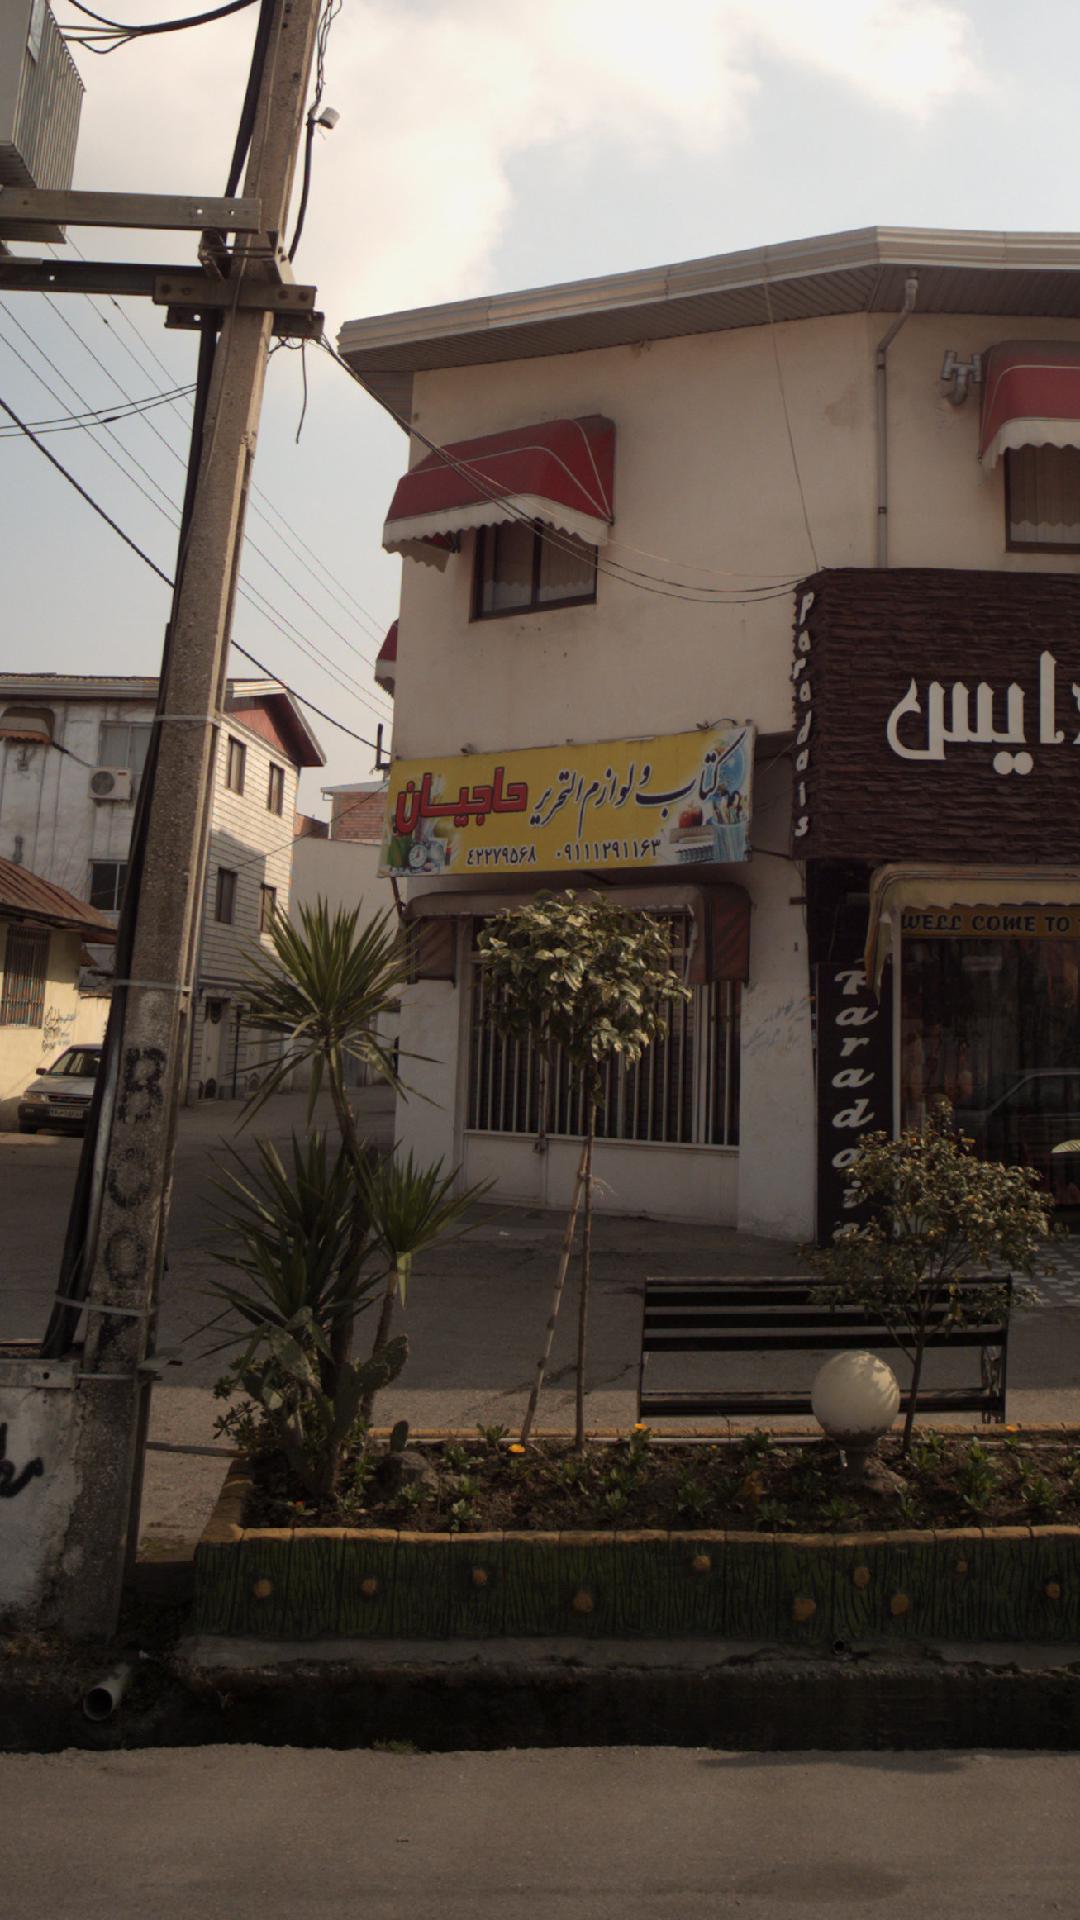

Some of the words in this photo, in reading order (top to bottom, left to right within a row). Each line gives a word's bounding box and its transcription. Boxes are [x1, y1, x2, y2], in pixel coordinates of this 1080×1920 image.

[394, 767, 529, 835] حاجیان
[530, 770, 585, 825] التحریر
[577, 763, 635, 838] لوازم
[635, 728, 747, 818] کتاب
[639, 765, 651, 785] و
[901, 914, 961, 931] WELL
[972, 915, 1036, 932] COME
[1045, 916, 1071, 932] TO
